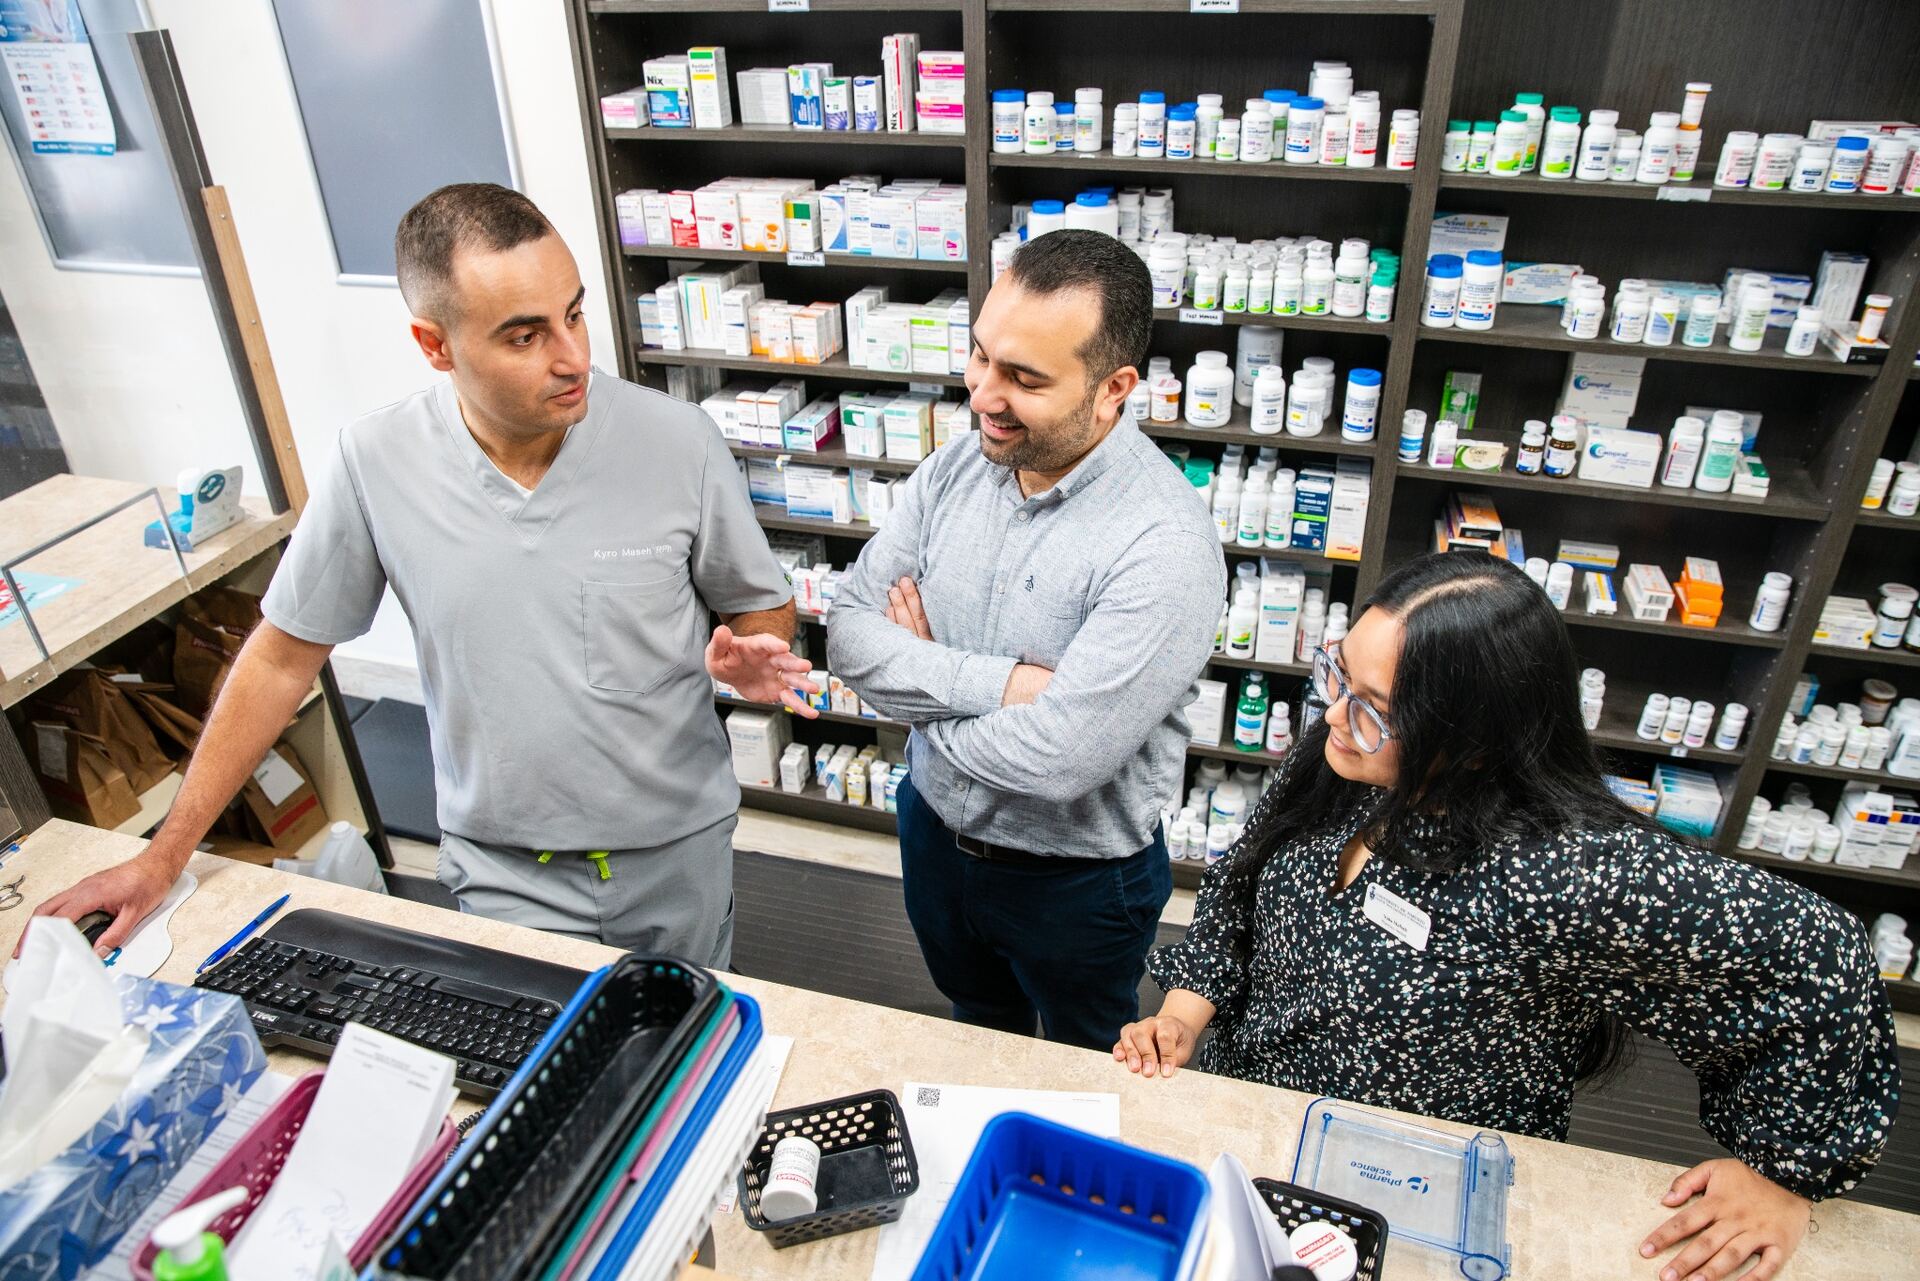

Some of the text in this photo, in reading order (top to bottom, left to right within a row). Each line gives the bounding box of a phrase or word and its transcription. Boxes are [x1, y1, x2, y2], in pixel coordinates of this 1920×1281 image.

[646, 76, 664, 86] Nix
[593, 549, 618, 560] Kyro
[1350, 1161, 1392, 1176] science
[1360, 1170, 1403, 1186] pharma
